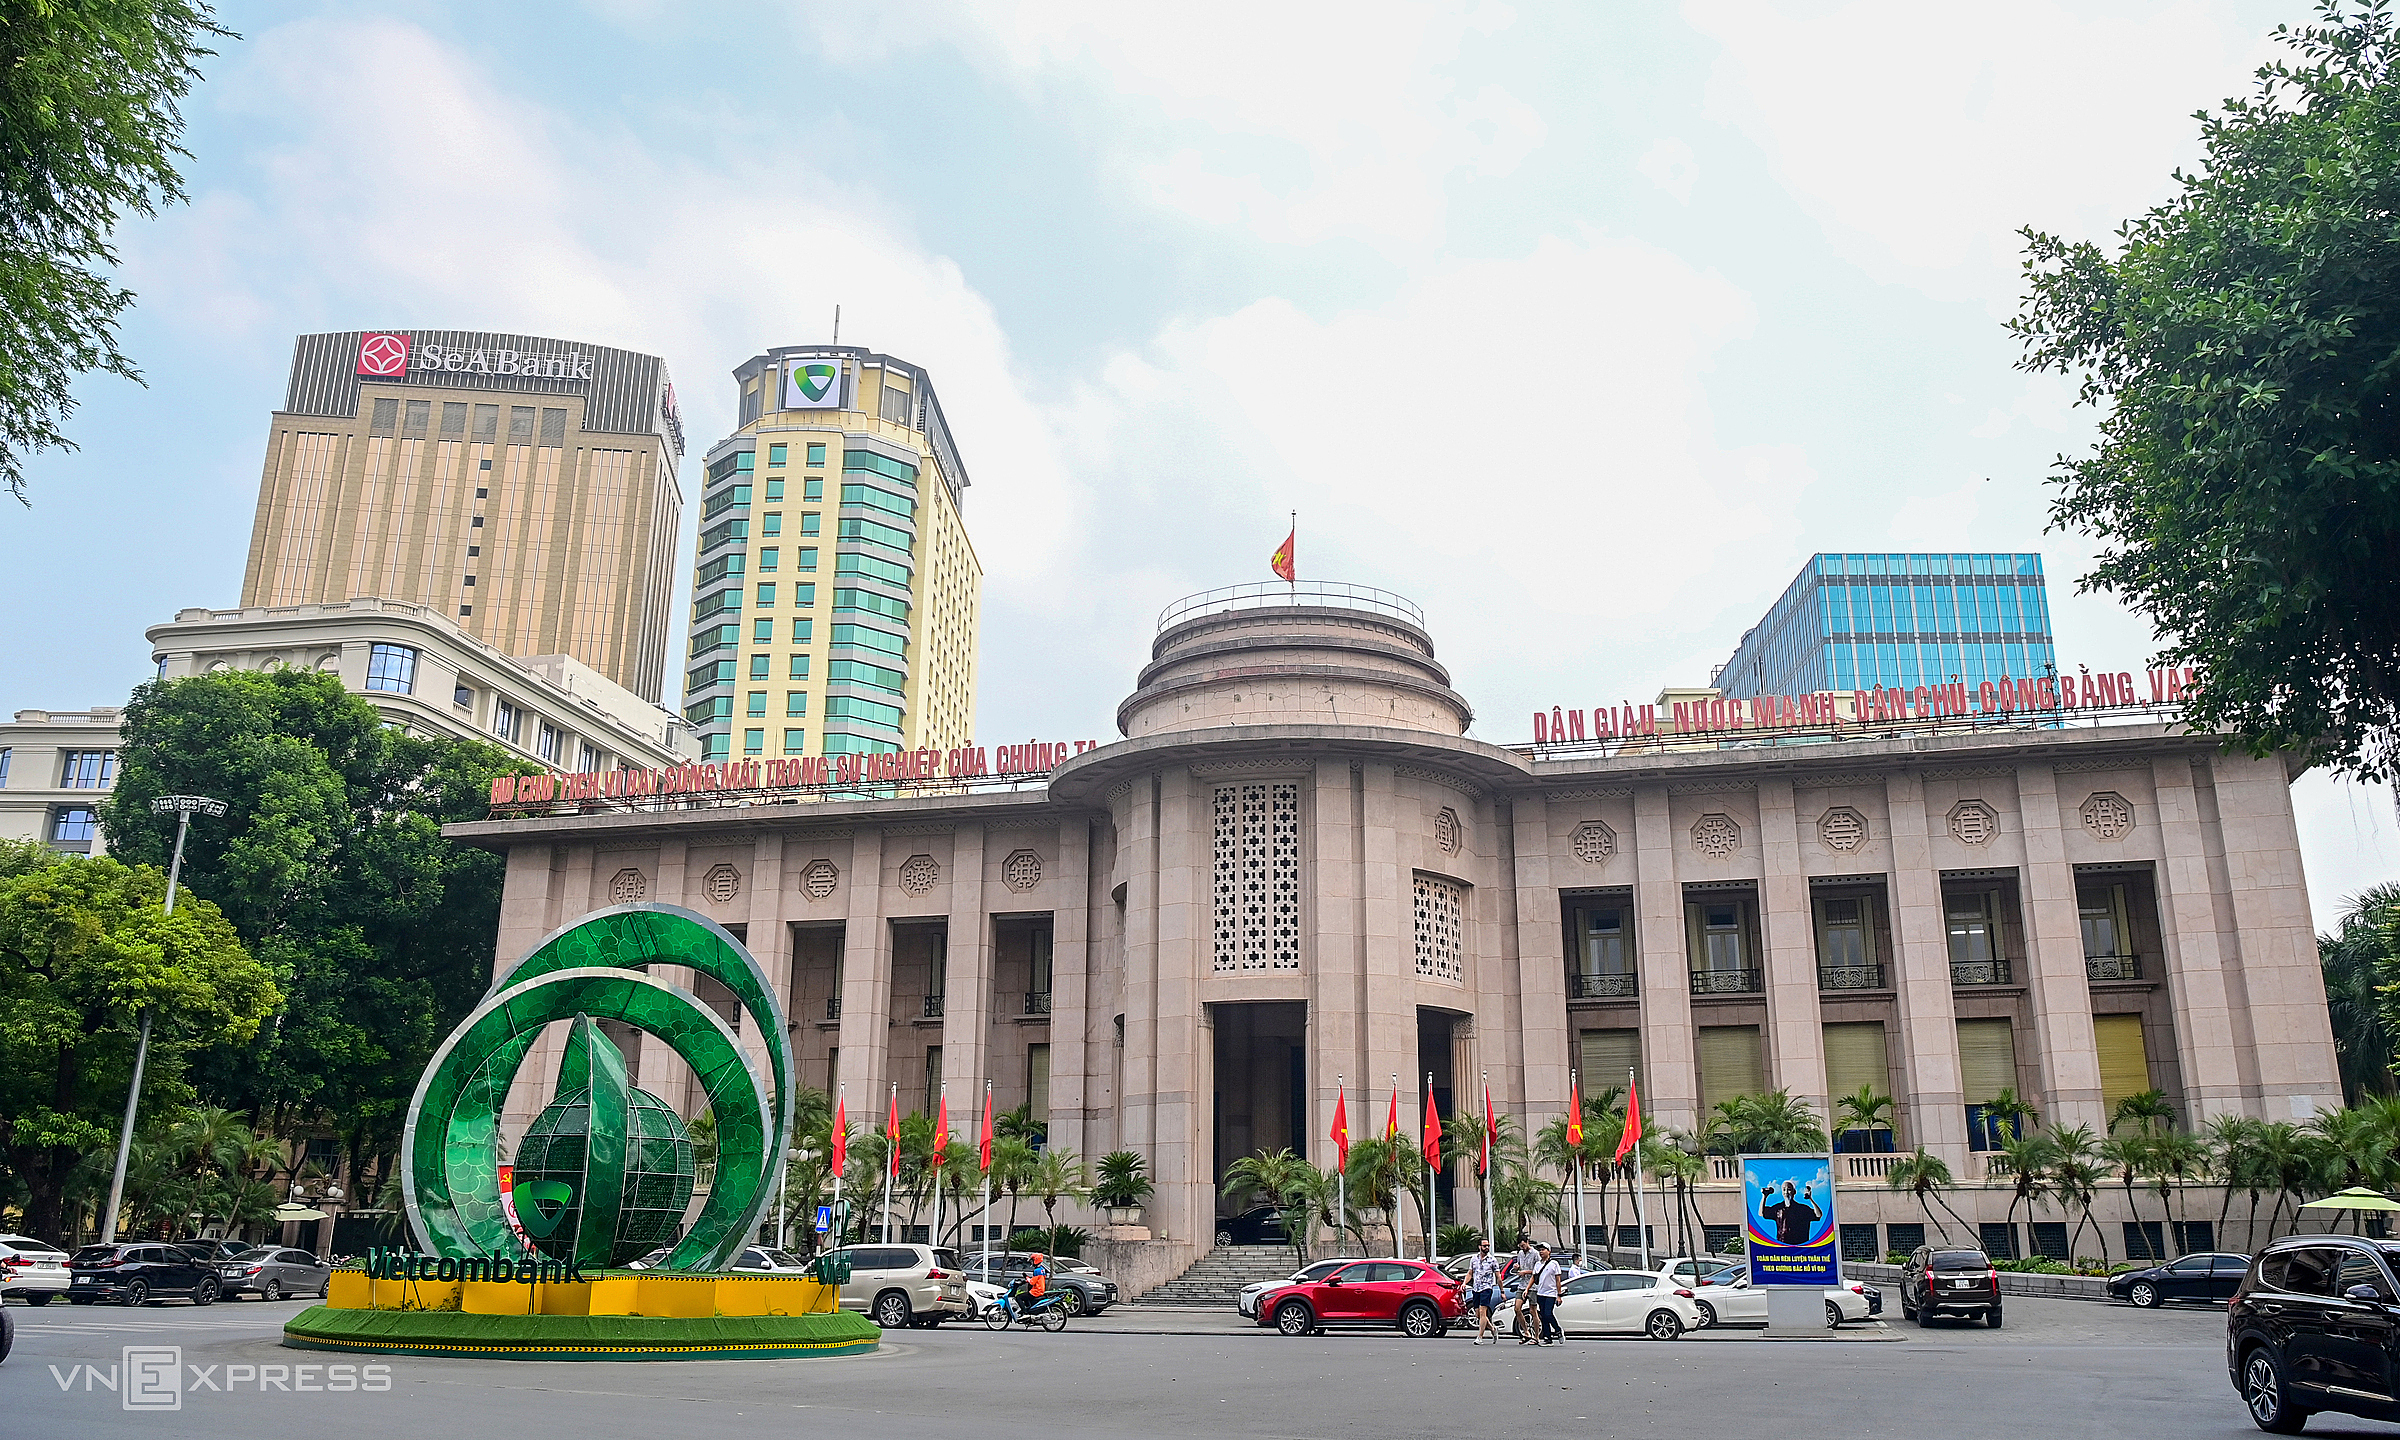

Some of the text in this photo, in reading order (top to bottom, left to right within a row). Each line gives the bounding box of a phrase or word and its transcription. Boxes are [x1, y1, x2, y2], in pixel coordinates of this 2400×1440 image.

[420, 344, 592, 380] SeABank
[1534, 705, 1585, 743] DÂN
[1673, 691, 1744, 733] NƯỚC
[1854, 683, 1907, 722] DÂN
[1979, 674, 2055, 713] CÔNG
[491, 769, 516, 805] HỒ
[518, 766, 556, 803] CHỦ
[560, 771, 601, 806] TỊCH
[604, 765, 625, 798] VĨ
[626, 767, 659, 801] ĐẠI
[663, 757, 716, 793] SỐNG
[720, 756, 760, 791] MÃI
[765, 756, 828, 788] TRONG
[835, 751, 864, 787] SỰ
[866, 745, 941, 785] NGHIỆP
[948, 739, 988, 778] CỦA
[996, 738, 1068, 774] CHÚNG
[364, 1245, 588, 1284] Vietcombank
